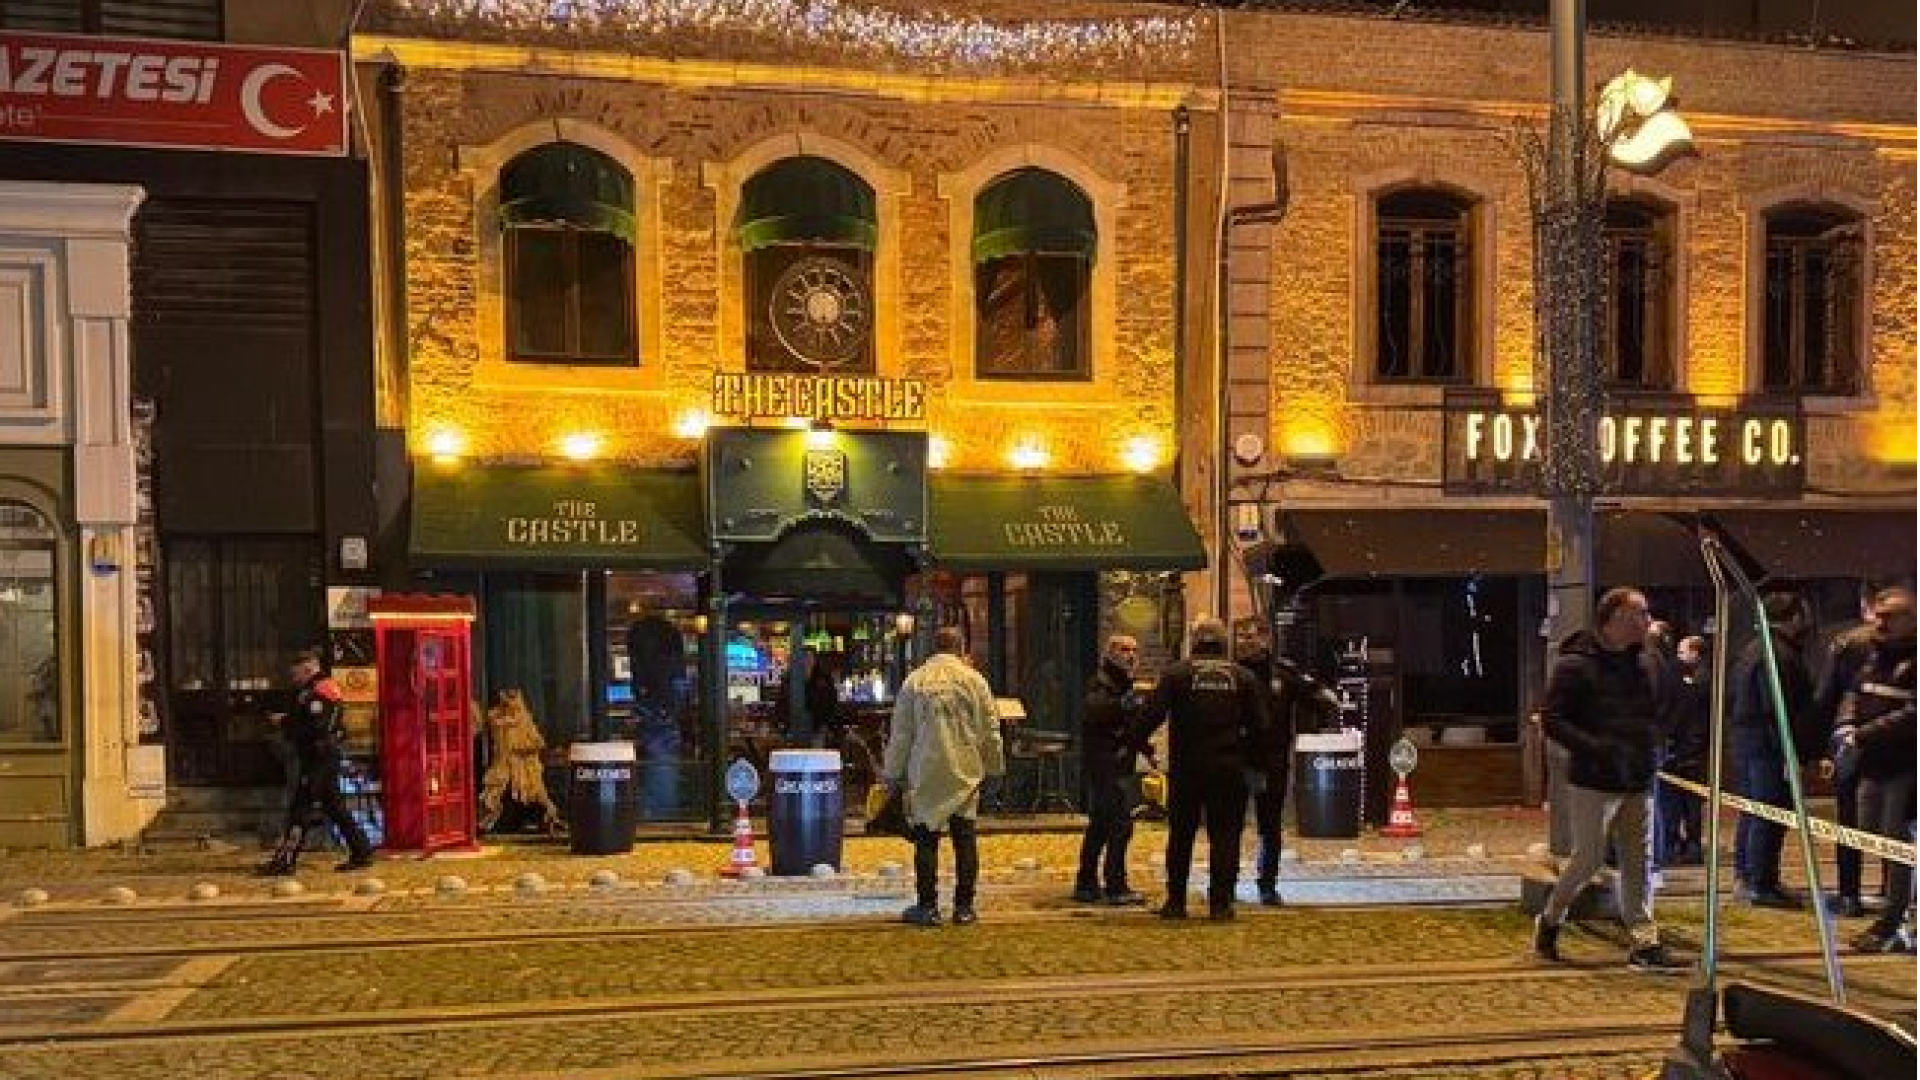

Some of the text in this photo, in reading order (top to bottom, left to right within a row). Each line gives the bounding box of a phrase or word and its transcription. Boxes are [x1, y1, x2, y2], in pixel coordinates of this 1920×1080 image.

[714, 375, 923, 419] THE CASTLE
[1465, 413, 1800, 466] FOX OFFEE CO.
[552, 500, 596, 518] THE
[1037, 505, 1078, 522] THE
[508, 517, 639, 543] CASTLE
[1003, 521, 1126, 546] CASTLE
